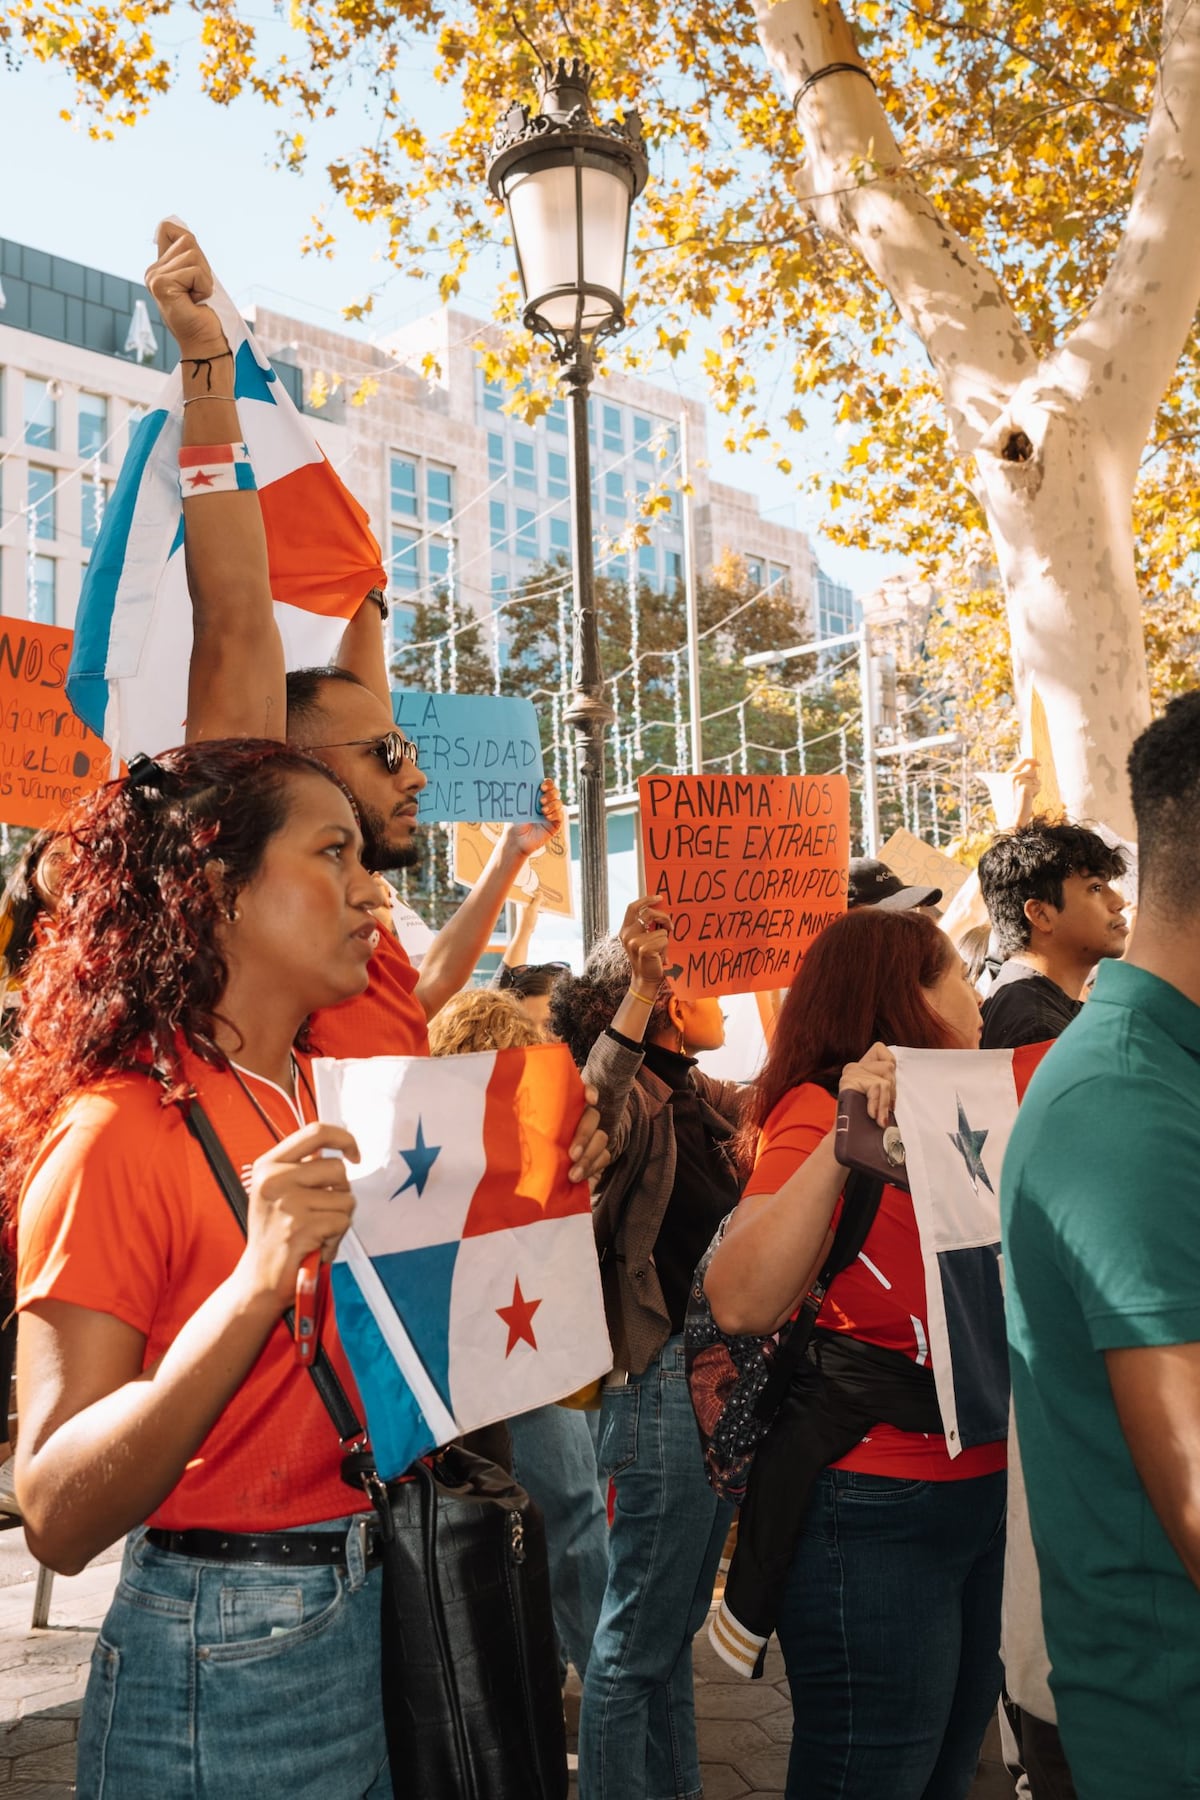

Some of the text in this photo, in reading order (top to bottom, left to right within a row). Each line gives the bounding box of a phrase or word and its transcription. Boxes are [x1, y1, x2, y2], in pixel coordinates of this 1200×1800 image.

[395, 695, 440, 728] LA
[410, 734, 537, 770] ERSIDAD
[787, 781, 833, 820] NOS
[649, 823, 838, 861] URGE EXTRAER
[655, 870, 671, 906] A
[677, 869, 727, 904] LOS
[734, 867, 848, 902] CORRUPTOS
[698, 909, 794, 941] EXTRAER
[686, 947, 790, 989] MORATORIA
